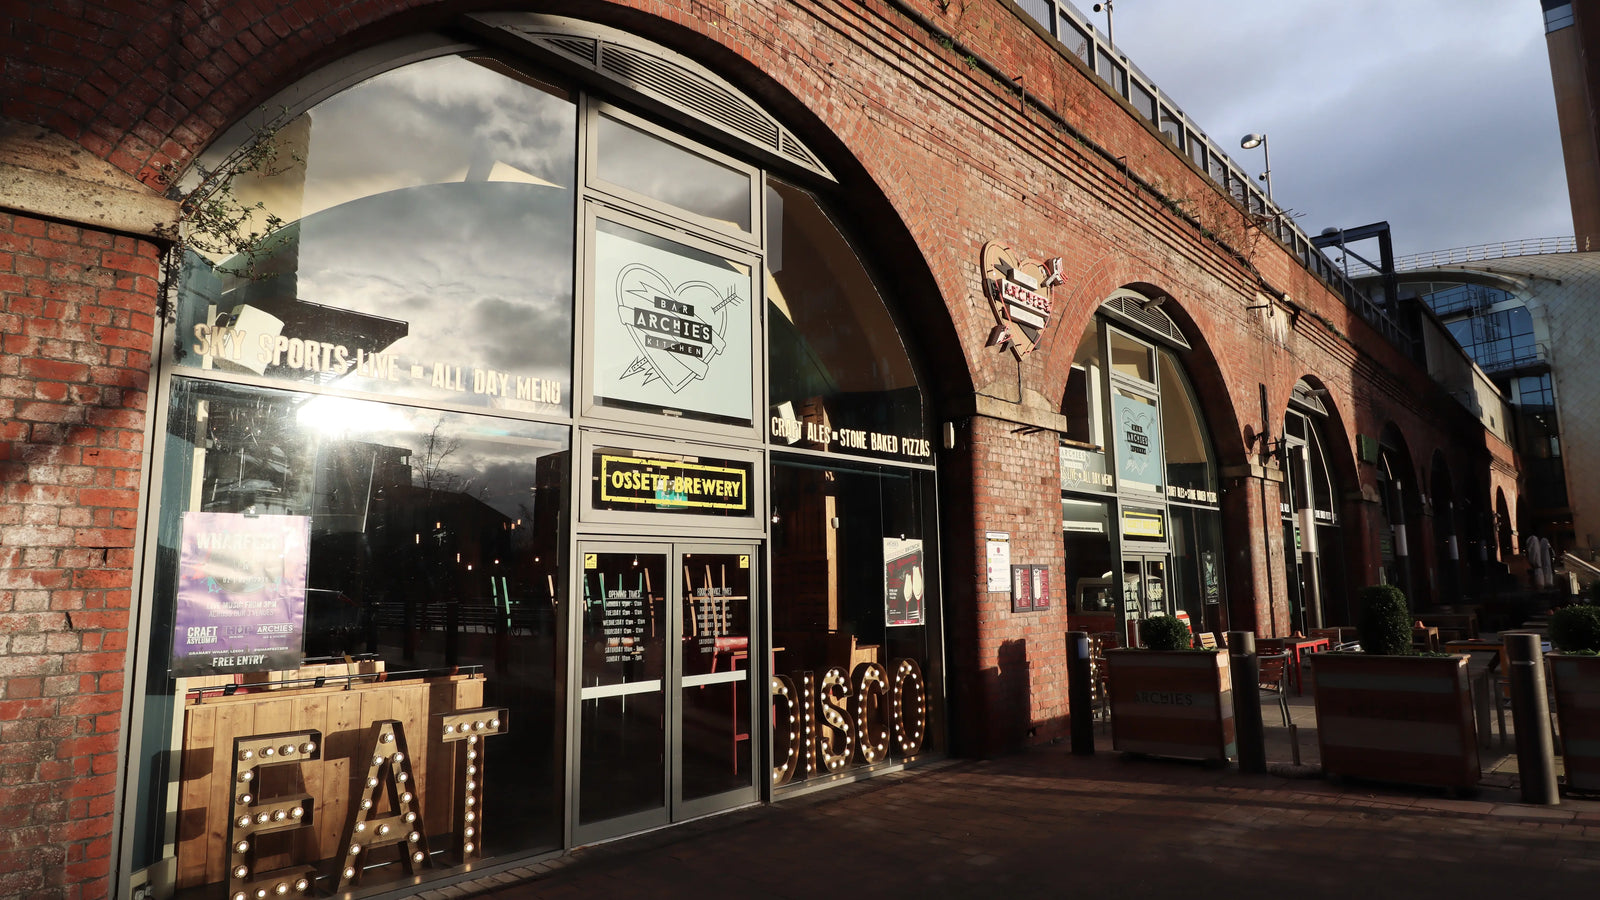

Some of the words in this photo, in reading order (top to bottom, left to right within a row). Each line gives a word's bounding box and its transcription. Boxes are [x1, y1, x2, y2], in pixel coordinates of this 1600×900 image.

[660, 300, 688, 314] BAR
[647, 338, 701, 355] KITCHEN
[193, 323, 246, 360] SKY
[257, 333, 349, 375] SPORTS
[356, 348, 399, 382] LIVE
[432, 362, 465, 392] ALL
[473, 368, 509, 397] DAY
[516, 375, 561, 404] MENU
[771, 416, 803, 439] CRAFT
[807, 421, 831, 444] ALES
[840, 428, 867, 450] STONE
[871, 432, 898, 453] BAKED
[902, 437, 930, 457] PIZZAS
[611, 470, 670, 491] OSSETT
[674, 476, 741, 497] BREWERY
[608, 590, 627, 598] OPENING
[628, 590, 640, 598] TIMES
[187, 626, 218, 637] CRAFT
[257, 624, 293, 633] ARCHIES
[212, 656, 234, 667] FREE
[237, 655, 264, 666] ENTRY
[1134, 692, 1193, 706] ARCHIES
[772, 658, 926, 786] DISCO
[226, 707, 509, 900] EAT
